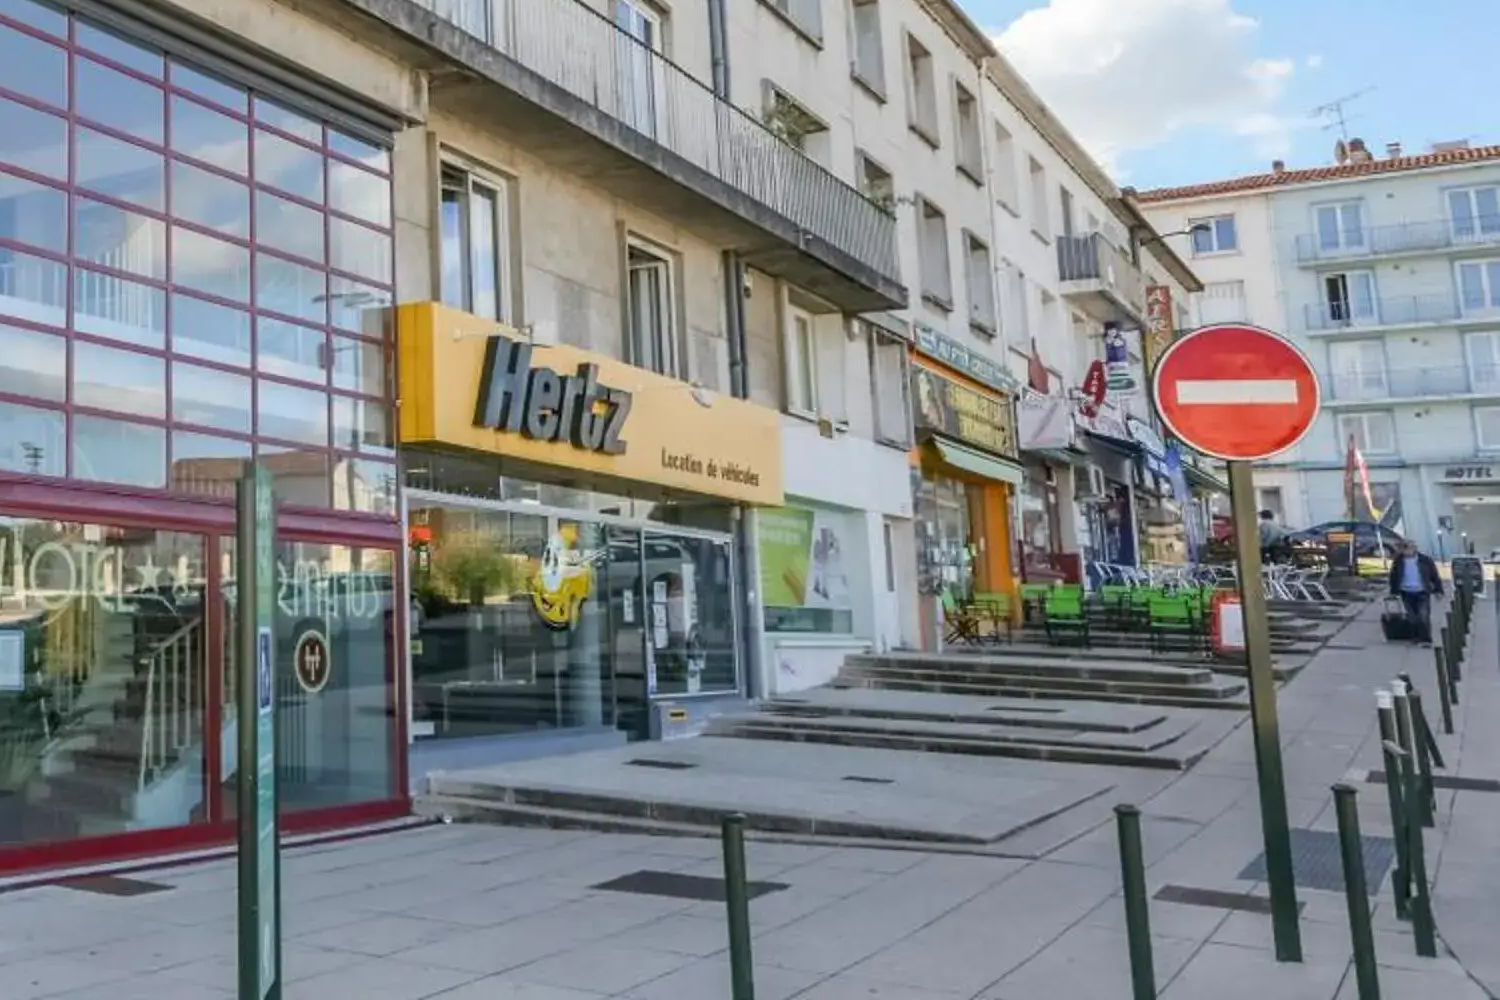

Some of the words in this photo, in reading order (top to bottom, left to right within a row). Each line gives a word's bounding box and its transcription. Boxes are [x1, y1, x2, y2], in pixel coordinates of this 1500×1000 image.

[471, 334, 634, 457] Hertz
[661, 445, 704, 475] Location
[706, 457, 718, 479] de
